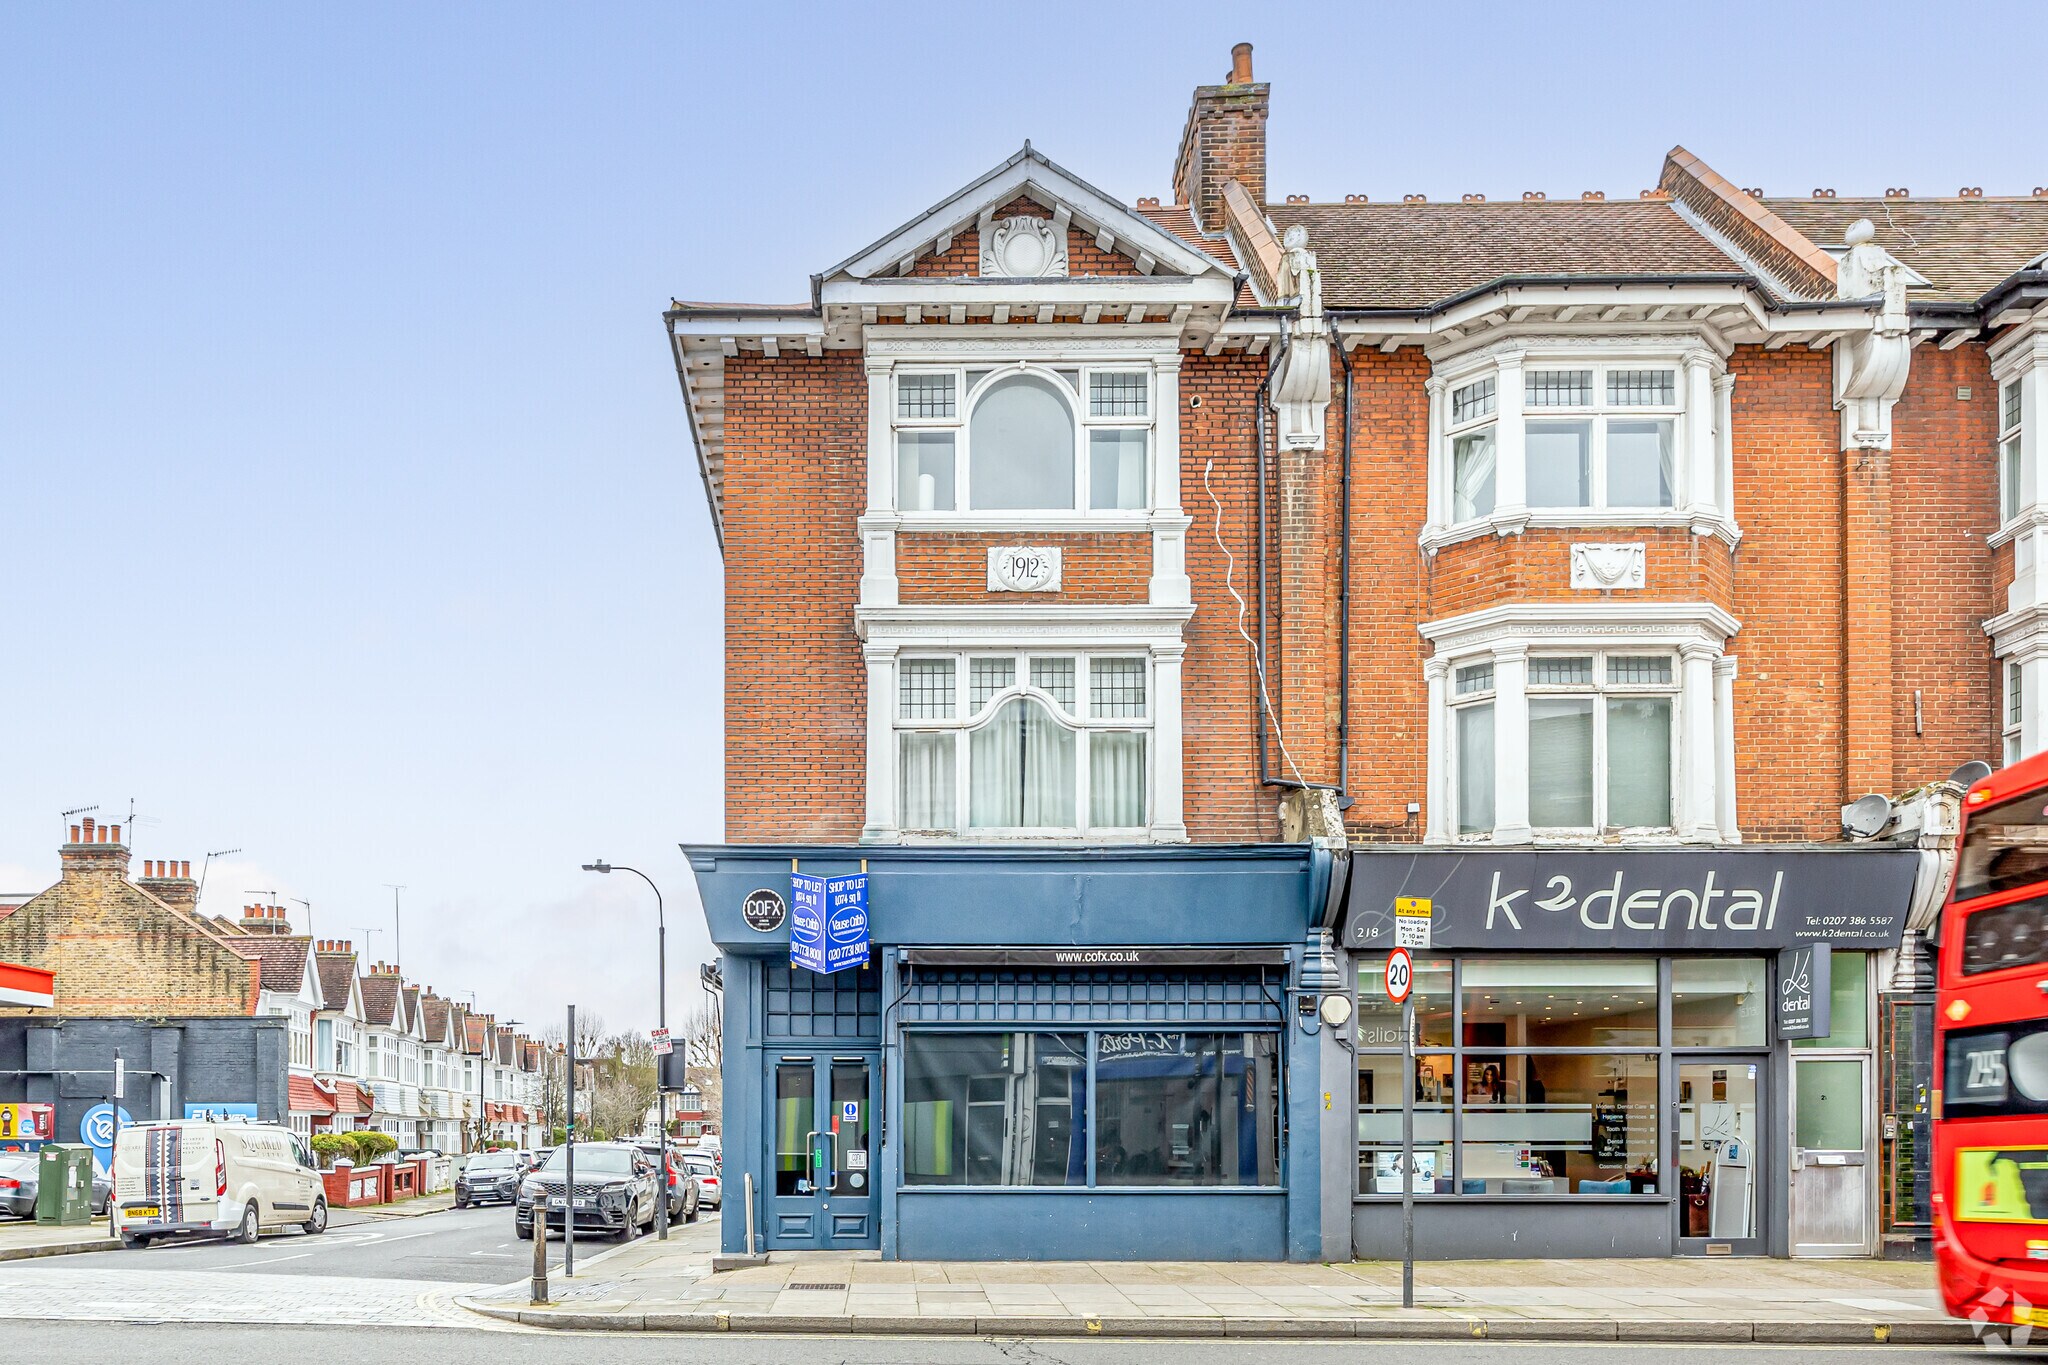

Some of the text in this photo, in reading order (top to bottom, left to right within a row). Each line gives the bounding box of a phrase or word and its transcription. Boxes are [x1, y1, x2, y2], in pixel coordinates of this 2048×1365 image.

[1012, 557, 1040, 581] 1912
[793, 878, 822, 893] SHOP TO LET
[828, 878, 865, 893] SHOP TO LET
[747, 900, 780, 916] COFX
[832, 914, 864, 931] Vause Cribb
[1806, 916, 1894, 925] Tel: 0207 386 5587
[1357, 928, 1378, 938] 218
[1795, 929, 1890, 938] www.k2dental.co.uk
[828, 948, 840, 961] 020
[841, 944, 854, 958] 7731
[855, 941, 867, 954] 8001
[1056, 950, 1140, 962] www.cofx.co.uk
[1390, 964, 1408, 986] 20
[1782, 995, 1810, 1012] dental
[652, 1028, 669, 1037] CASH
